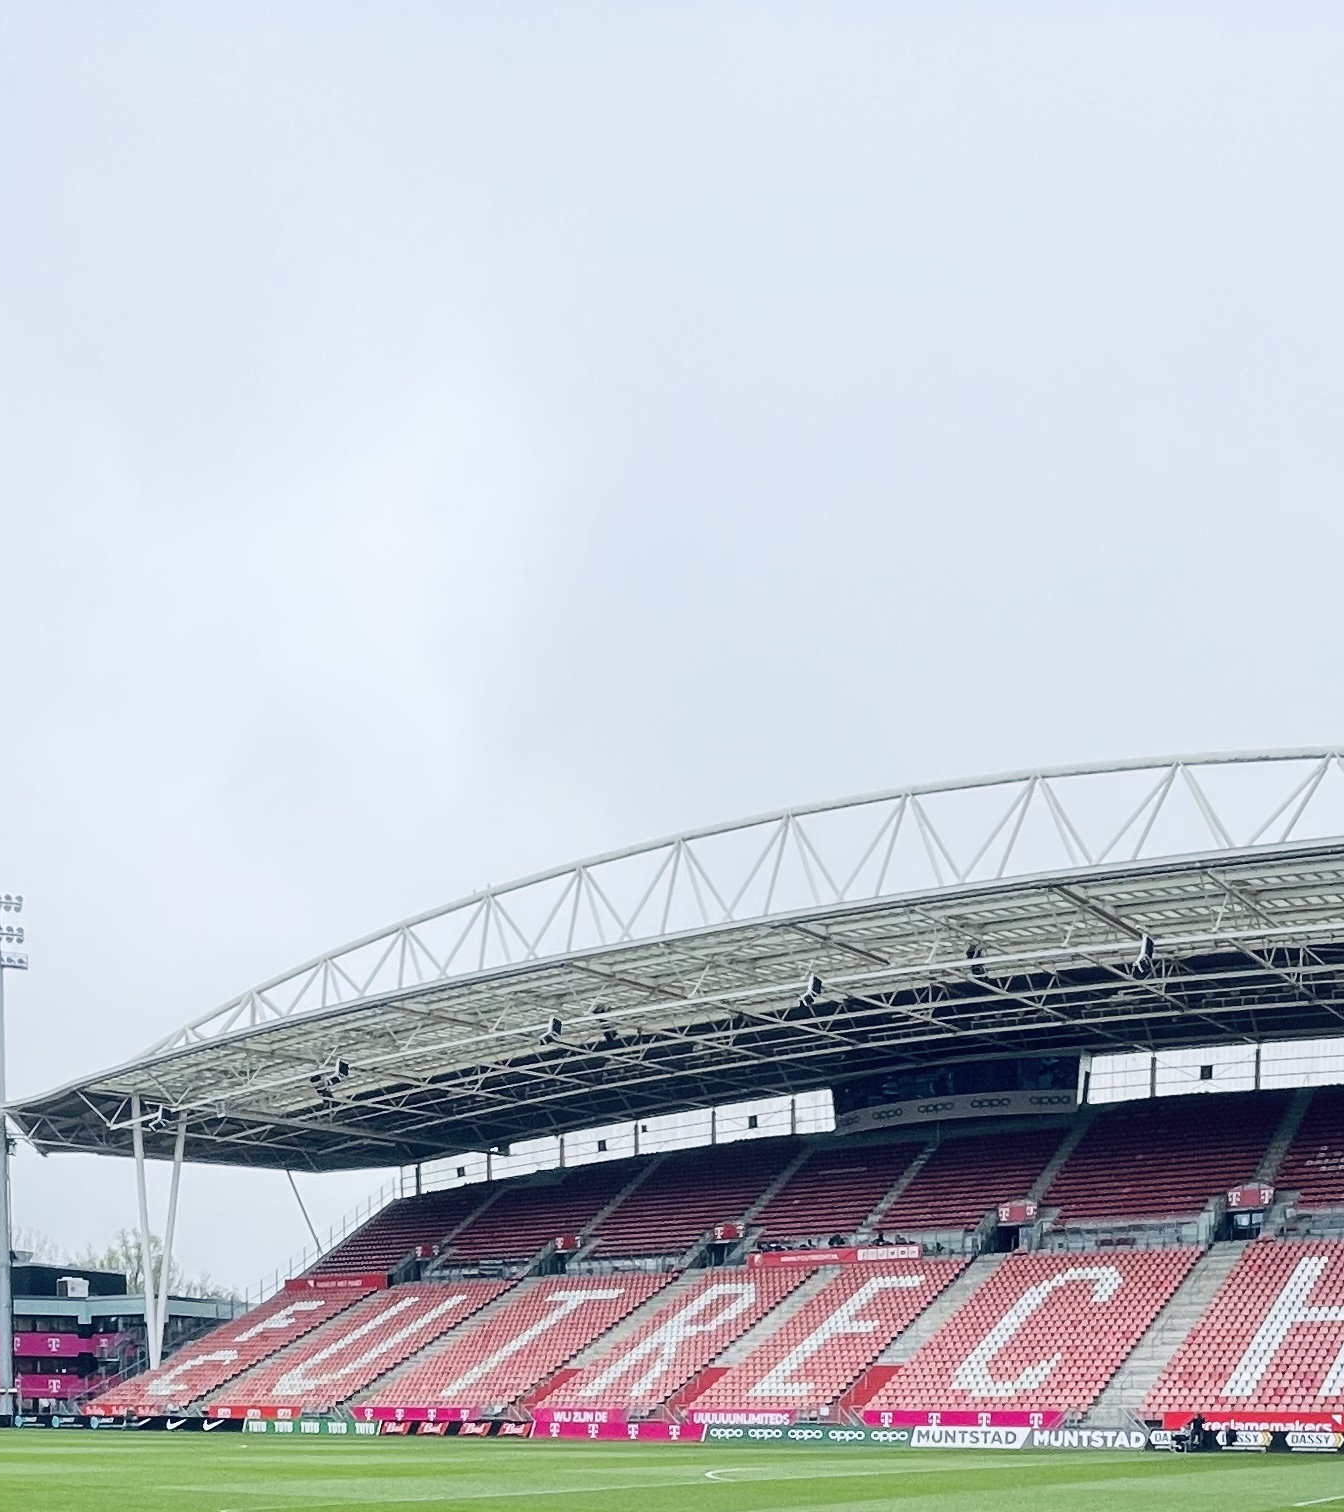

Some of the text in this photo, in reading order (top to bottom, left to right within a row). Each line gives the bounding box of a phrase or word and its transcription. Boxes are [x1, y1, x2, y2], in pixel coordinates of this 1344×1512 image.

[970, 1097, 1011, 1109] oppo
[595, 1411, 607, 1423] DE
[710, 1428, 743, 1439] oppo
[748, 1428, 783, 1440] oppo
[787, 1429, 823, 1441] oppo
[828, 1430, 865, 1441] oppo
[870, 1430, 908, 1442] oppo
[916, 1429, 1017, 1445] MUNTSTAD
[1032, 1429, 1146, 1448] MUNTSTAD
[1291, 1434, 1331, 1445] DASSY
